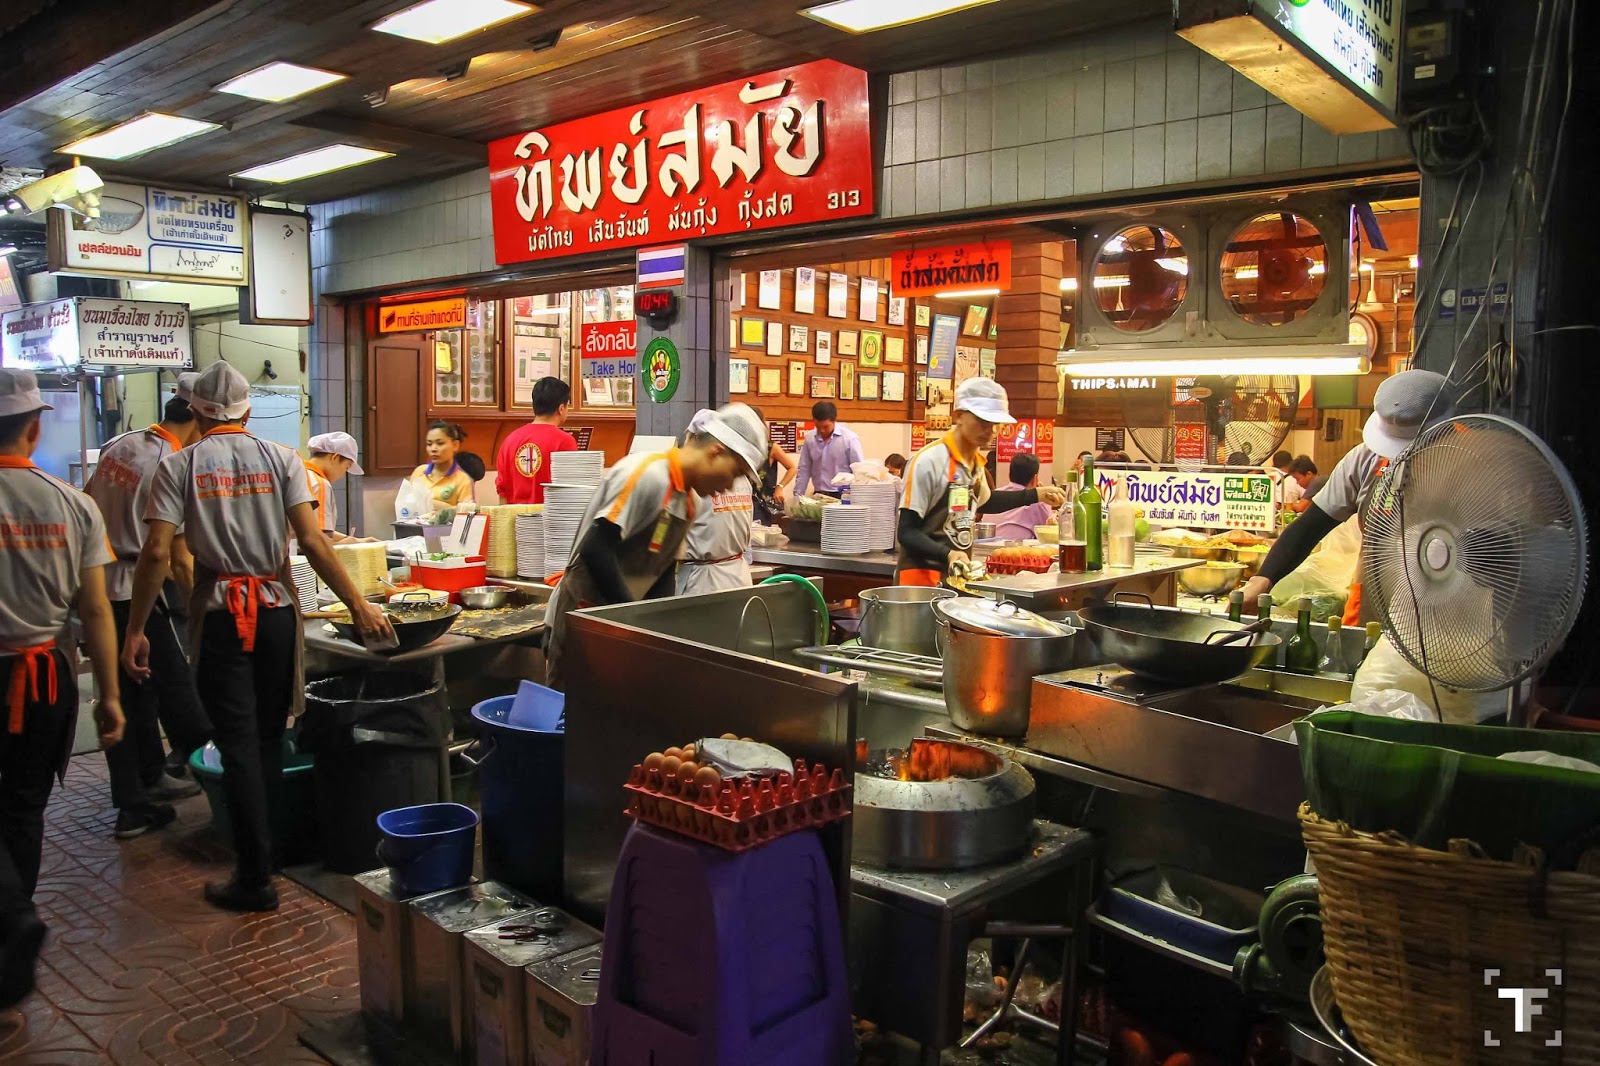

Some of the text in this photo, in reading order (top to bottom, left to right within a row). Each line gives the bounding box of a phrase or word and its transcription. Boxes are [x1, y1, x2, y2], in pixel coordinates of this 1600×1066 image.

[513, 78, 825, 222] ทิพย์สมัย
[528, 225, 574, 252] ผัดไทย
[667, 197, 718, 235] มันกุ้ง
[738, 188, 794, 230] กุ้งสด
[827, 188, 861, 211] 313
[591, 361, 615, 375] Take
[1126, 473, 1221, 507] ทิพย์สมัย
